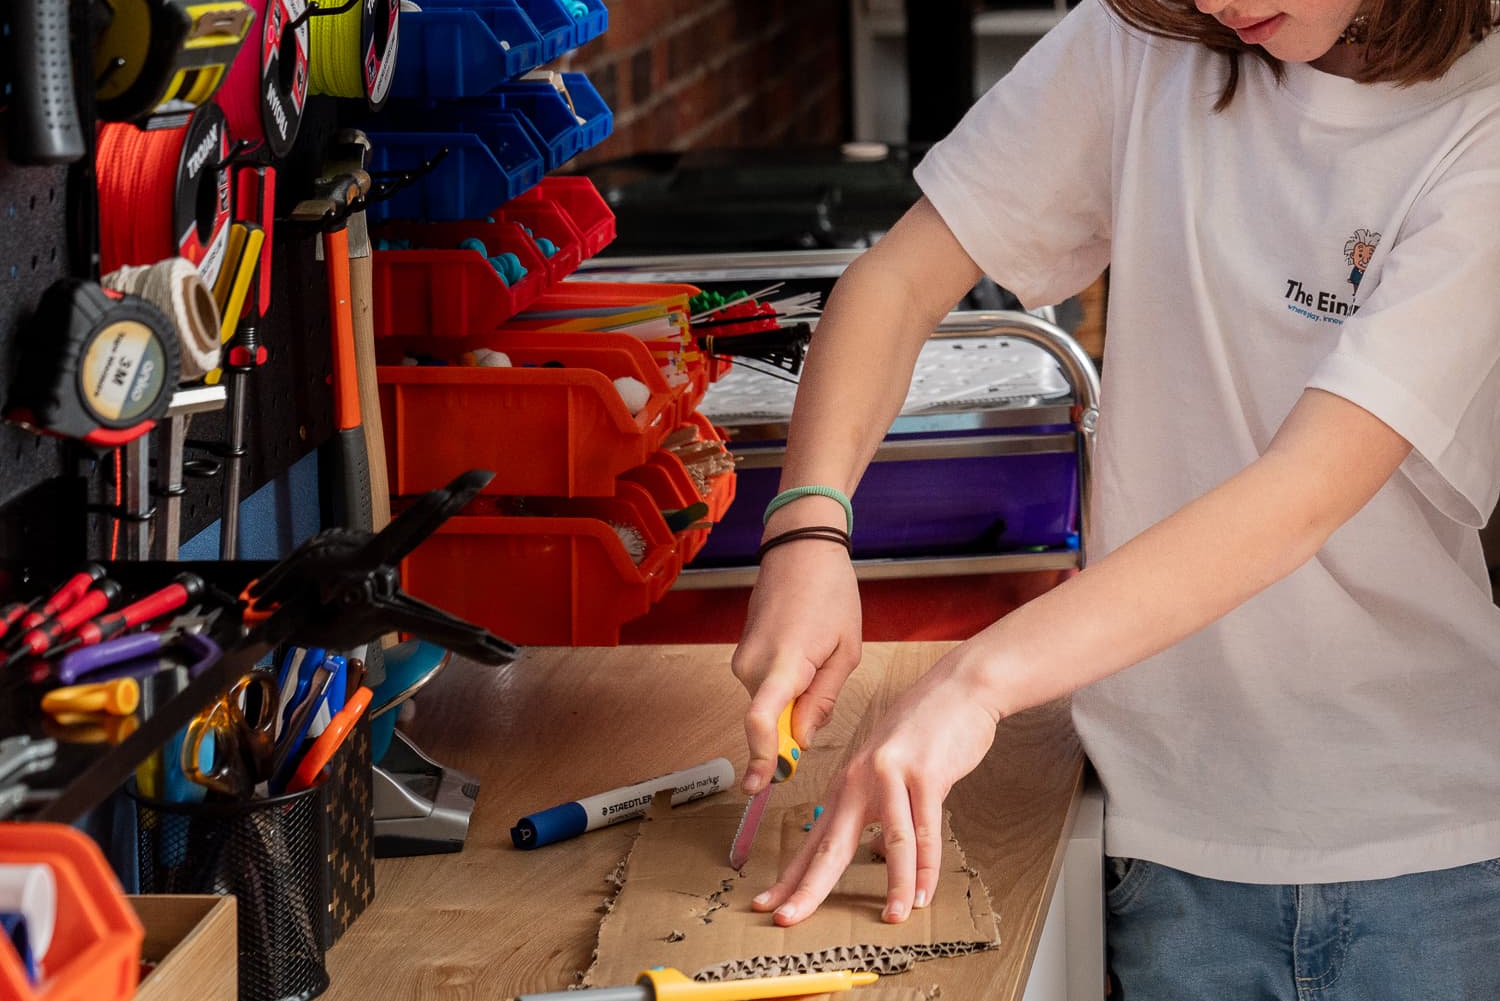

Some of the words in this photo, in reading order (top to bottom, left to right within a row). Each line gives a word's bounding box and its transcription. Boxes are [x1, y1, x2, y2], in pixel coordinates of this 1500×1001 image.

[187, 123, 217, 178] TROJAN
[1285, 279, 1314, 307] The
[696, 775, 720, 791] marker
